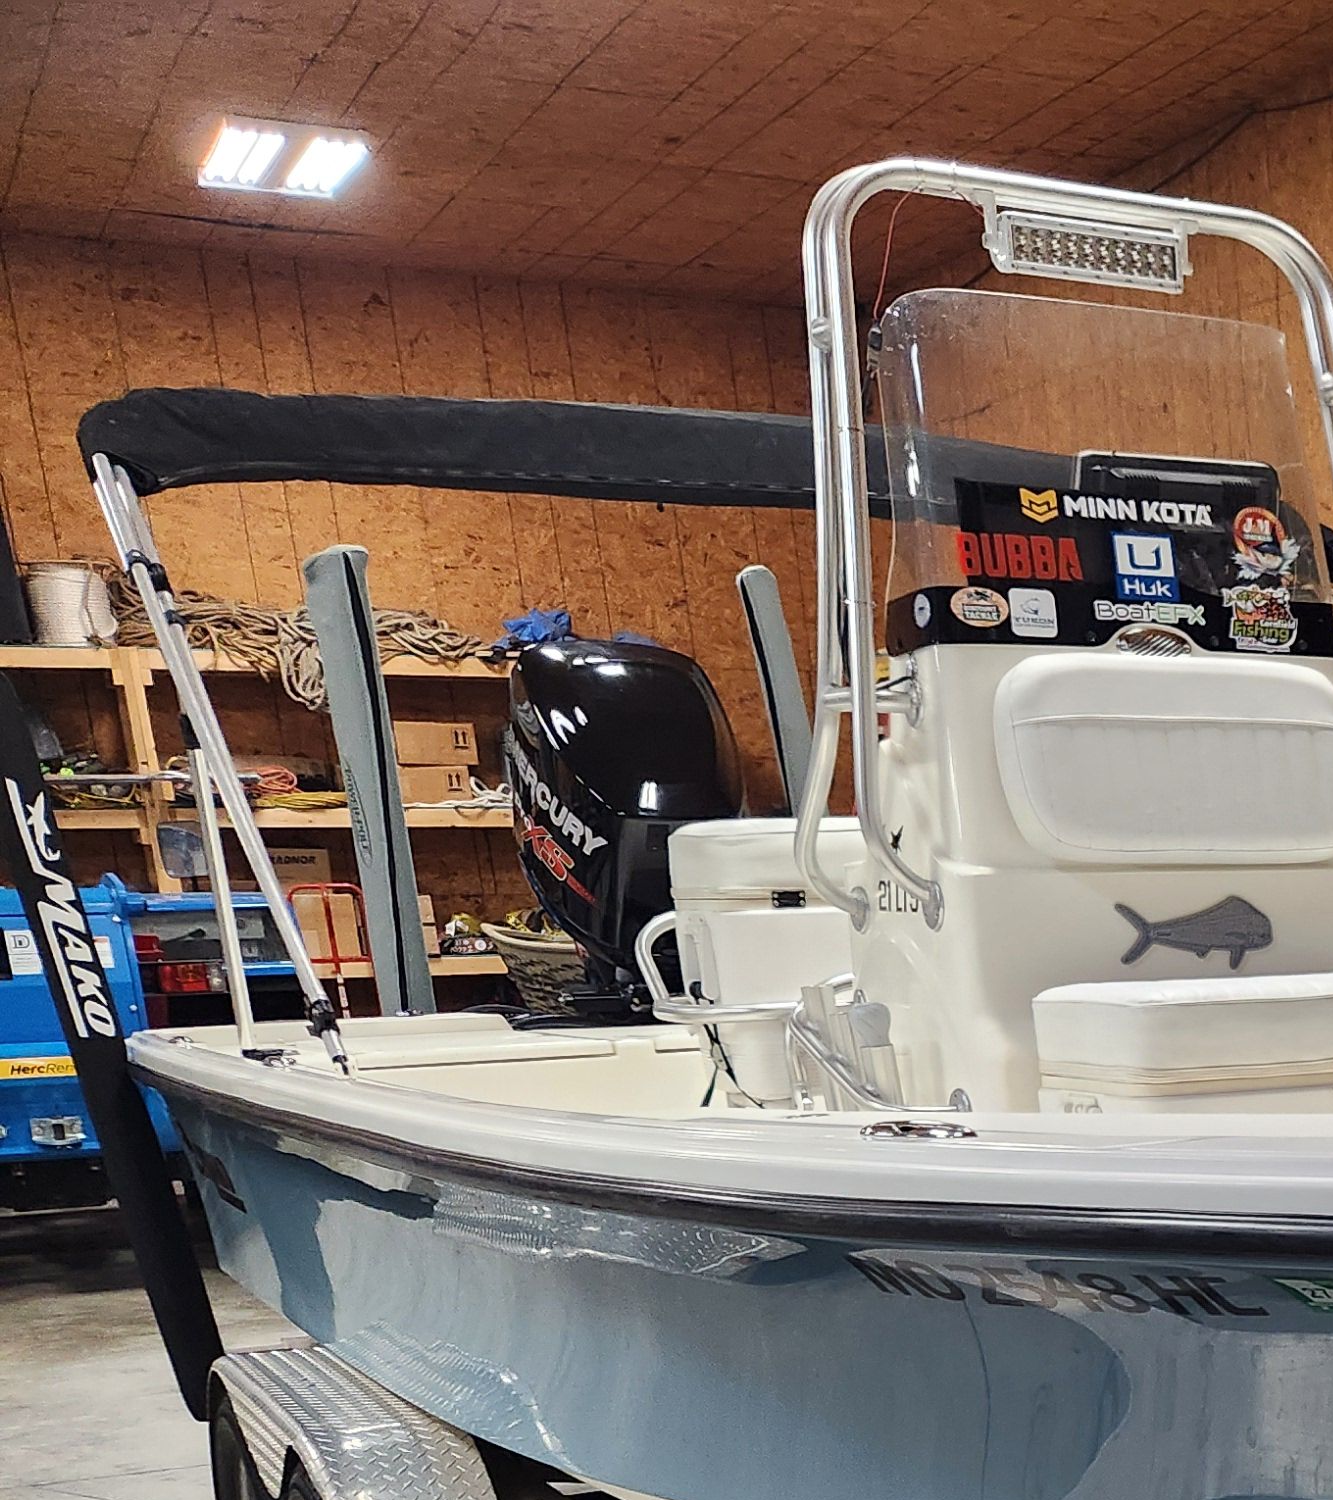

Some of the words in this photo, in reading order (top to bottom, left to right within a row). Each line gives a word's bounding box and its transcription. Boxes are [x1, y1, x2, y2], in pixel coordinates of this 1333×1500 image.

[1063, 495, 1138, 522] MINN
[1142, 501, 1214, 527] KOTA
[957, 532, 1085, 582] BUBBA
[1122, 577, 1173, 598] Huk
[1234, 620, 1290, 644] Fishing
[30, 848, 117, 1038] MAKO
[943, 1264, 1154, 1314] 2548
[1301, 1286, 1333, 1299] 27
